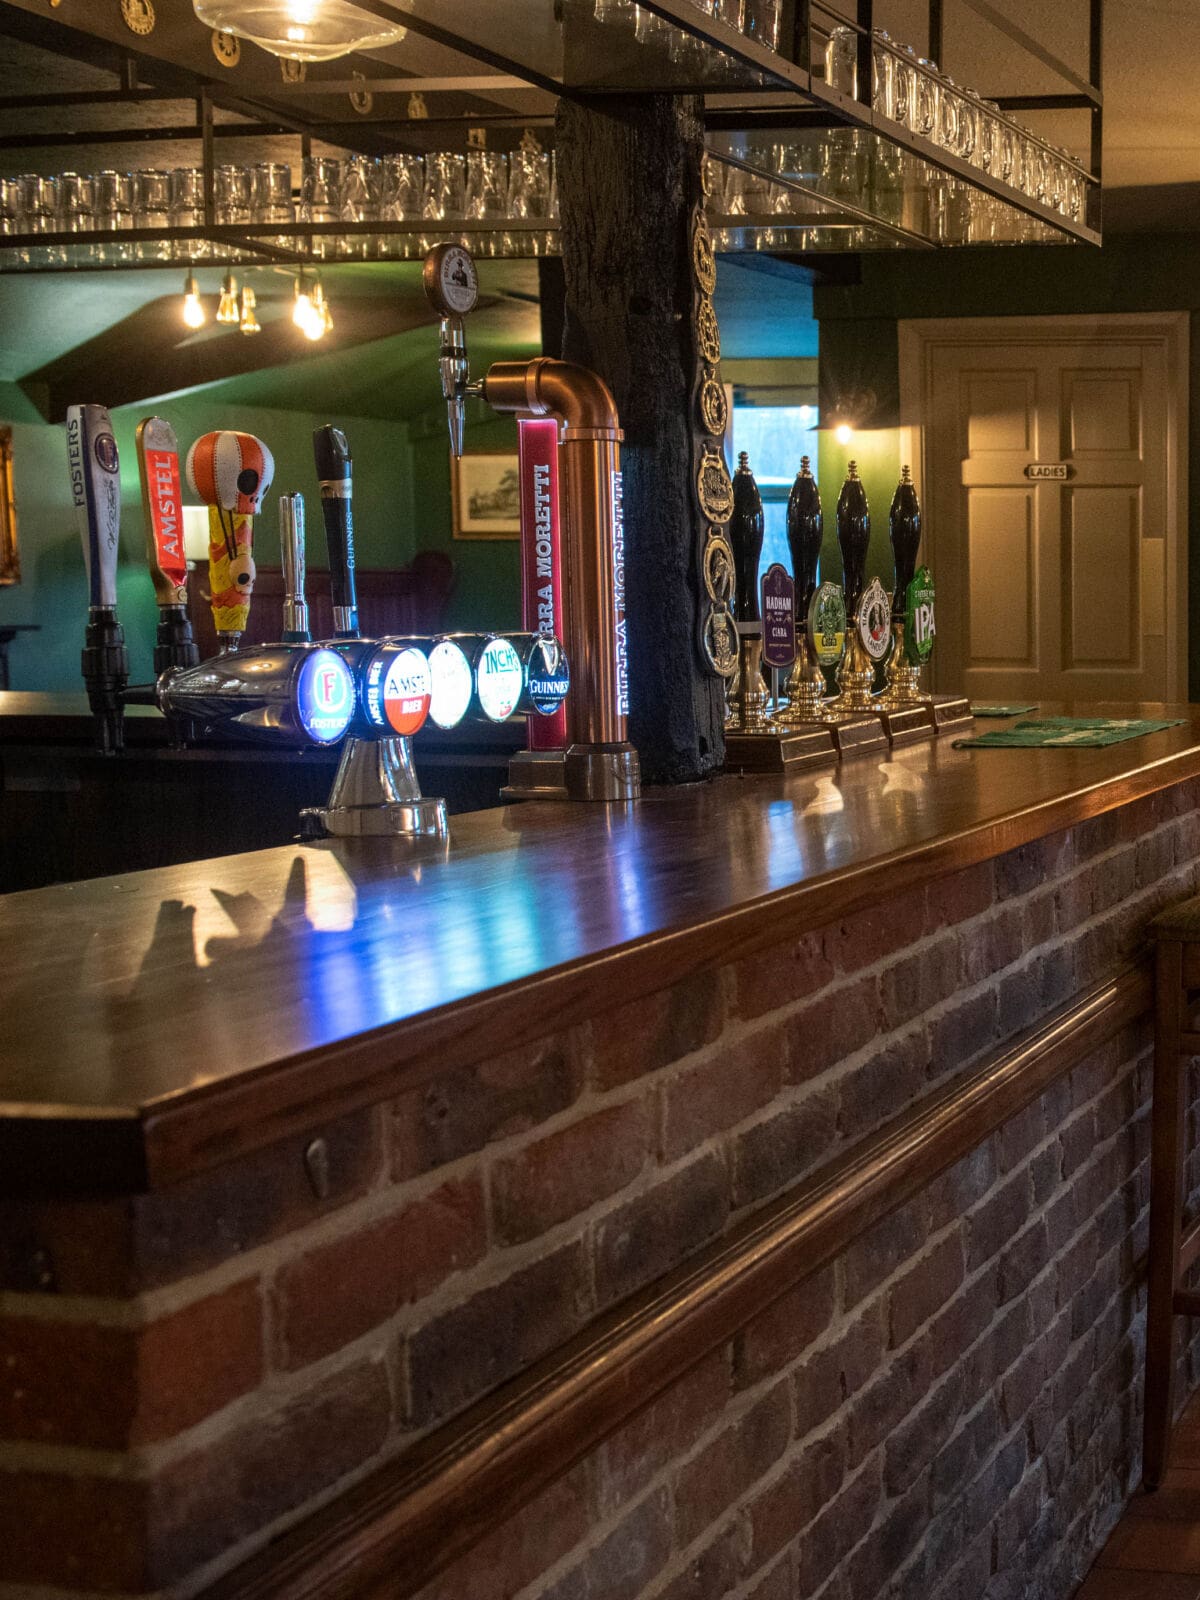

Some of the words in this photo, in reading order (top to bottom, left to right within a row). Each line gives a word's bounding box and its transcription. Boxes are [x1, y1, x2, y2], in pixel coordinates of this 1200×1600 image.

[1031, 467, 1065, 477] LADIES
[155, 456, 180, 558] AMSTEL
[534, 465, 552, 577] MORETTI
[537, 584, 553, 638] RRA
[766, 596, 791, 611] HADHAM
[915, 602, 937, 644] IPA
[323, 672, 335, 702] F
[389, 675, 425, 694] AMST
